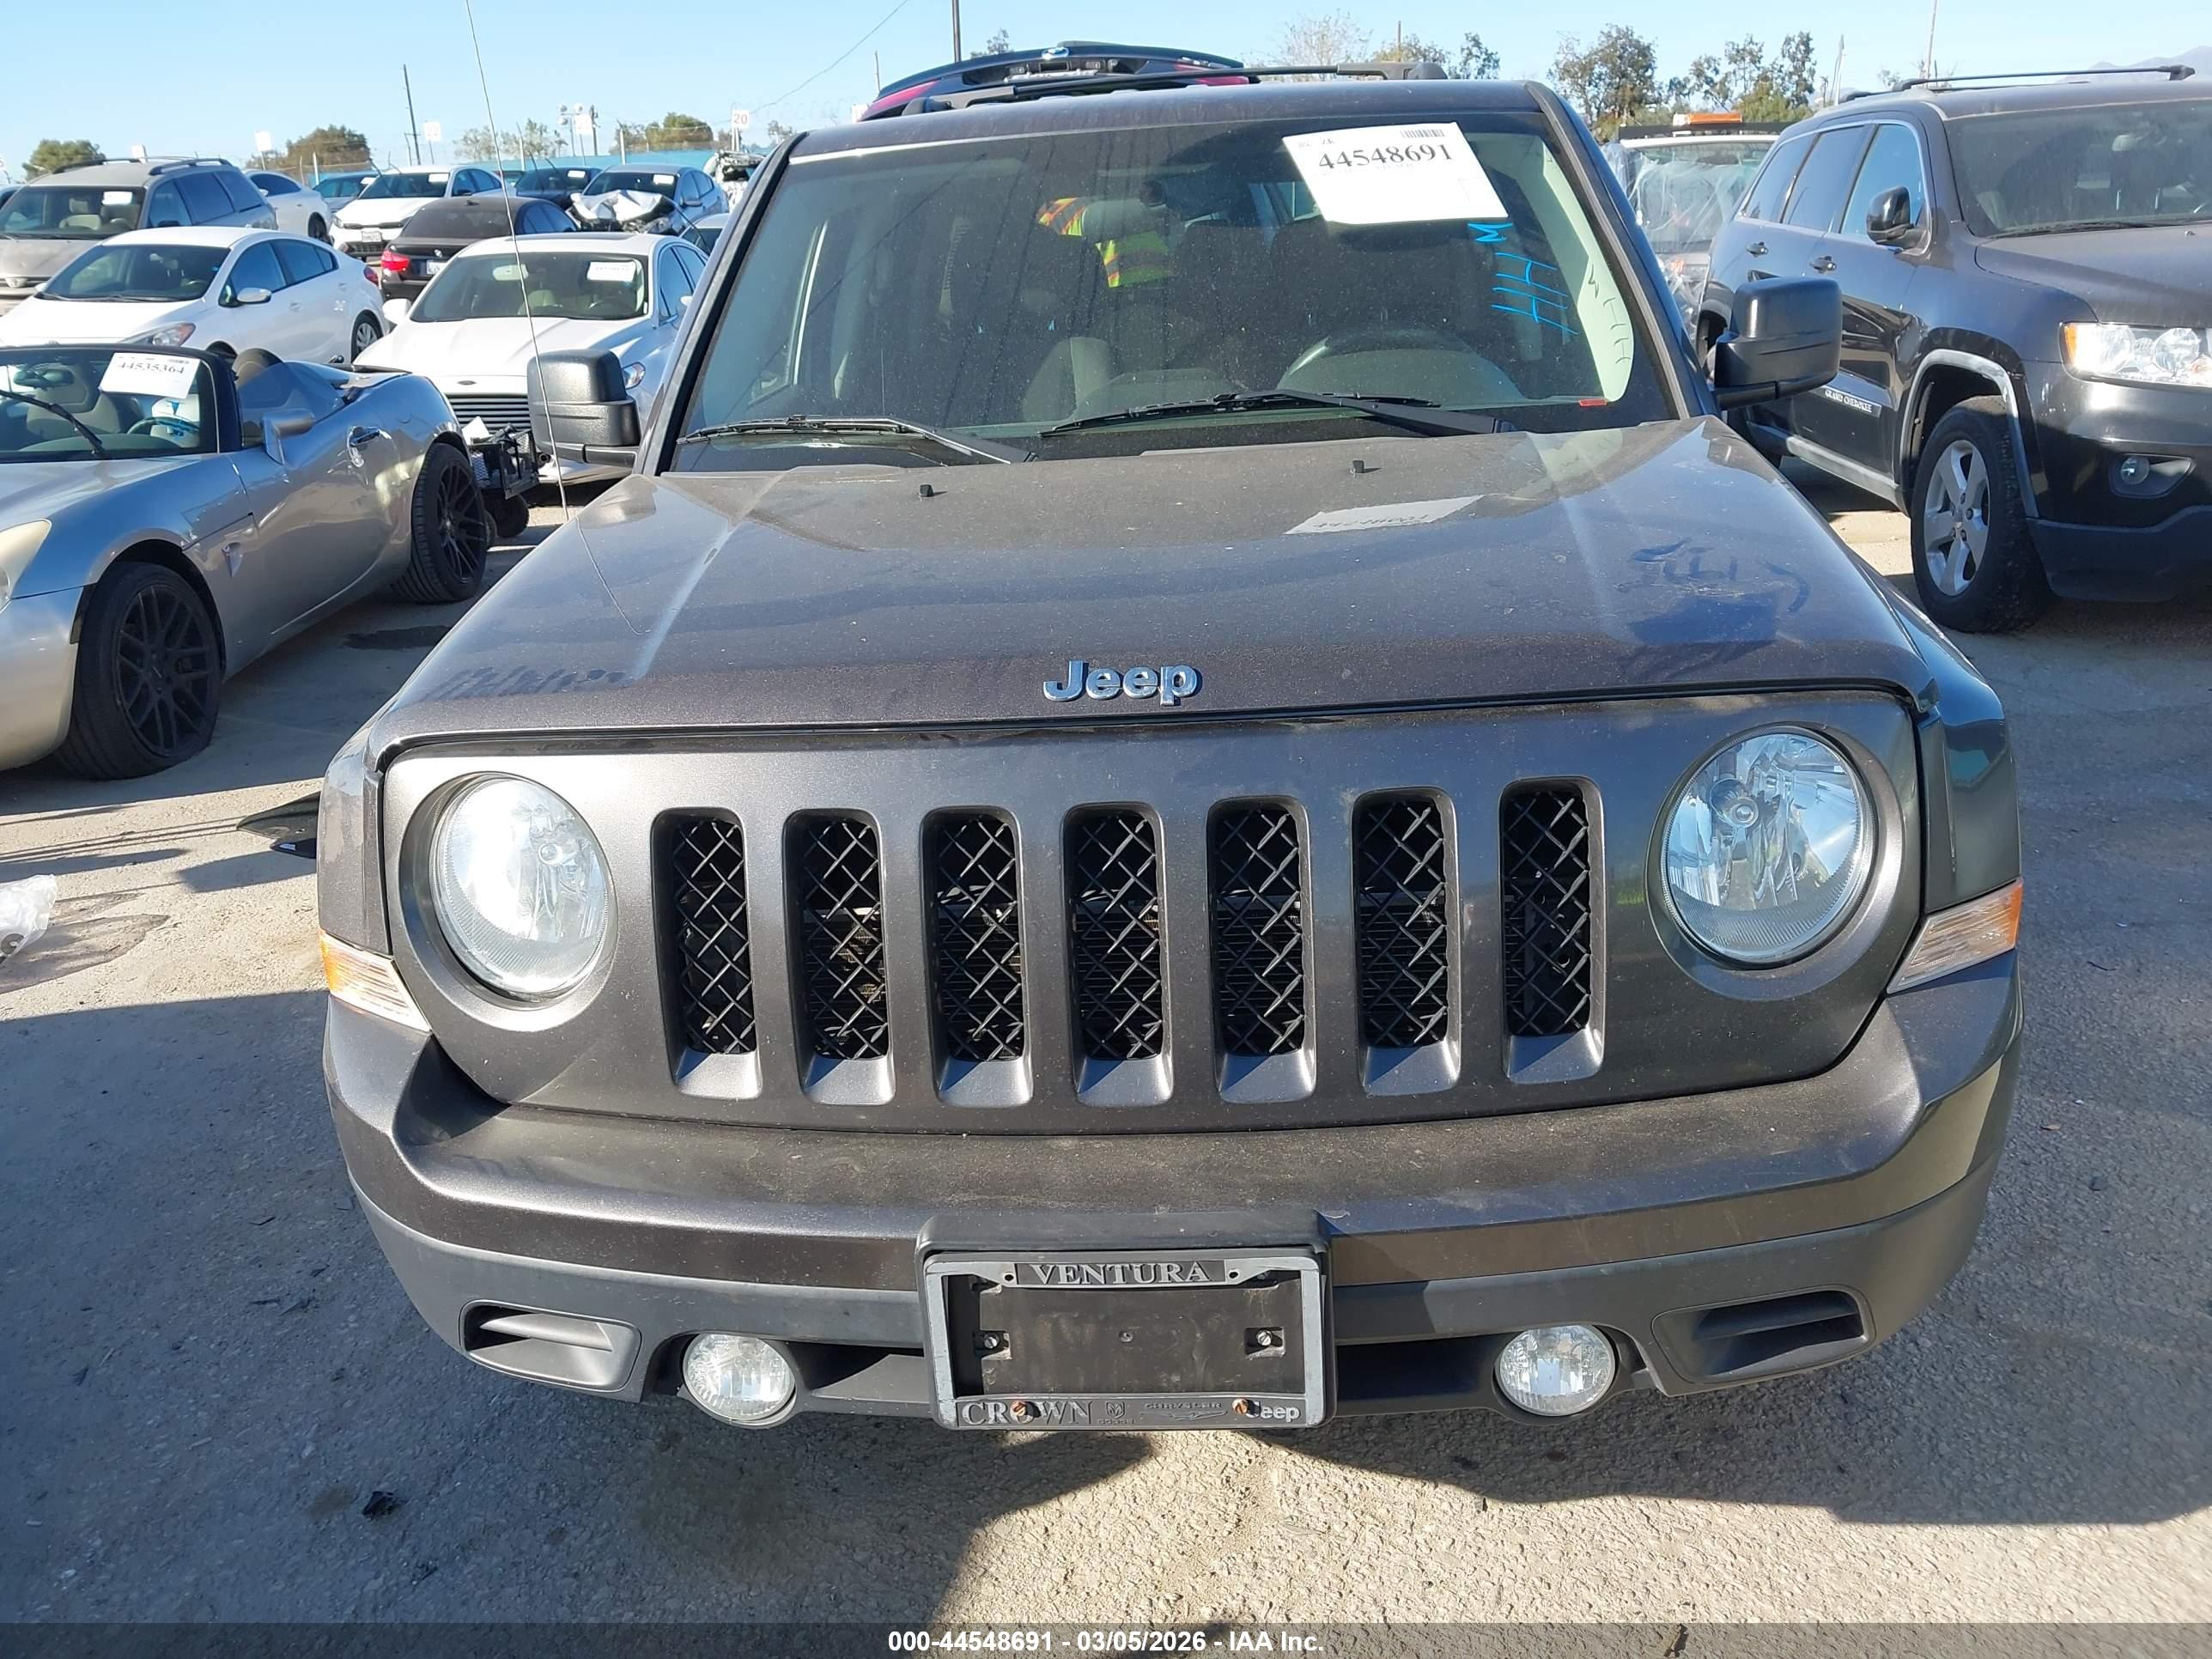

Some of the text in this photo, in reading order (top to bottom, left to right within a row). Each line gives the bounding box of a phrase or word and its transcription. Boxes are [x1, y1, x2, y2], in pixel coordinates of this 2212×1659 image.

[733, 112, 748, 125] 20
[1318, 143, 1454, 170] 44548691
[118, 362, 185, 374] 44535364
[1825, 389, 1872, 413] GRAND CHEROKEE
[1043, 659, 1199, 707] Jeep
[1031, 1261, 1212, 1285] VENTURA
